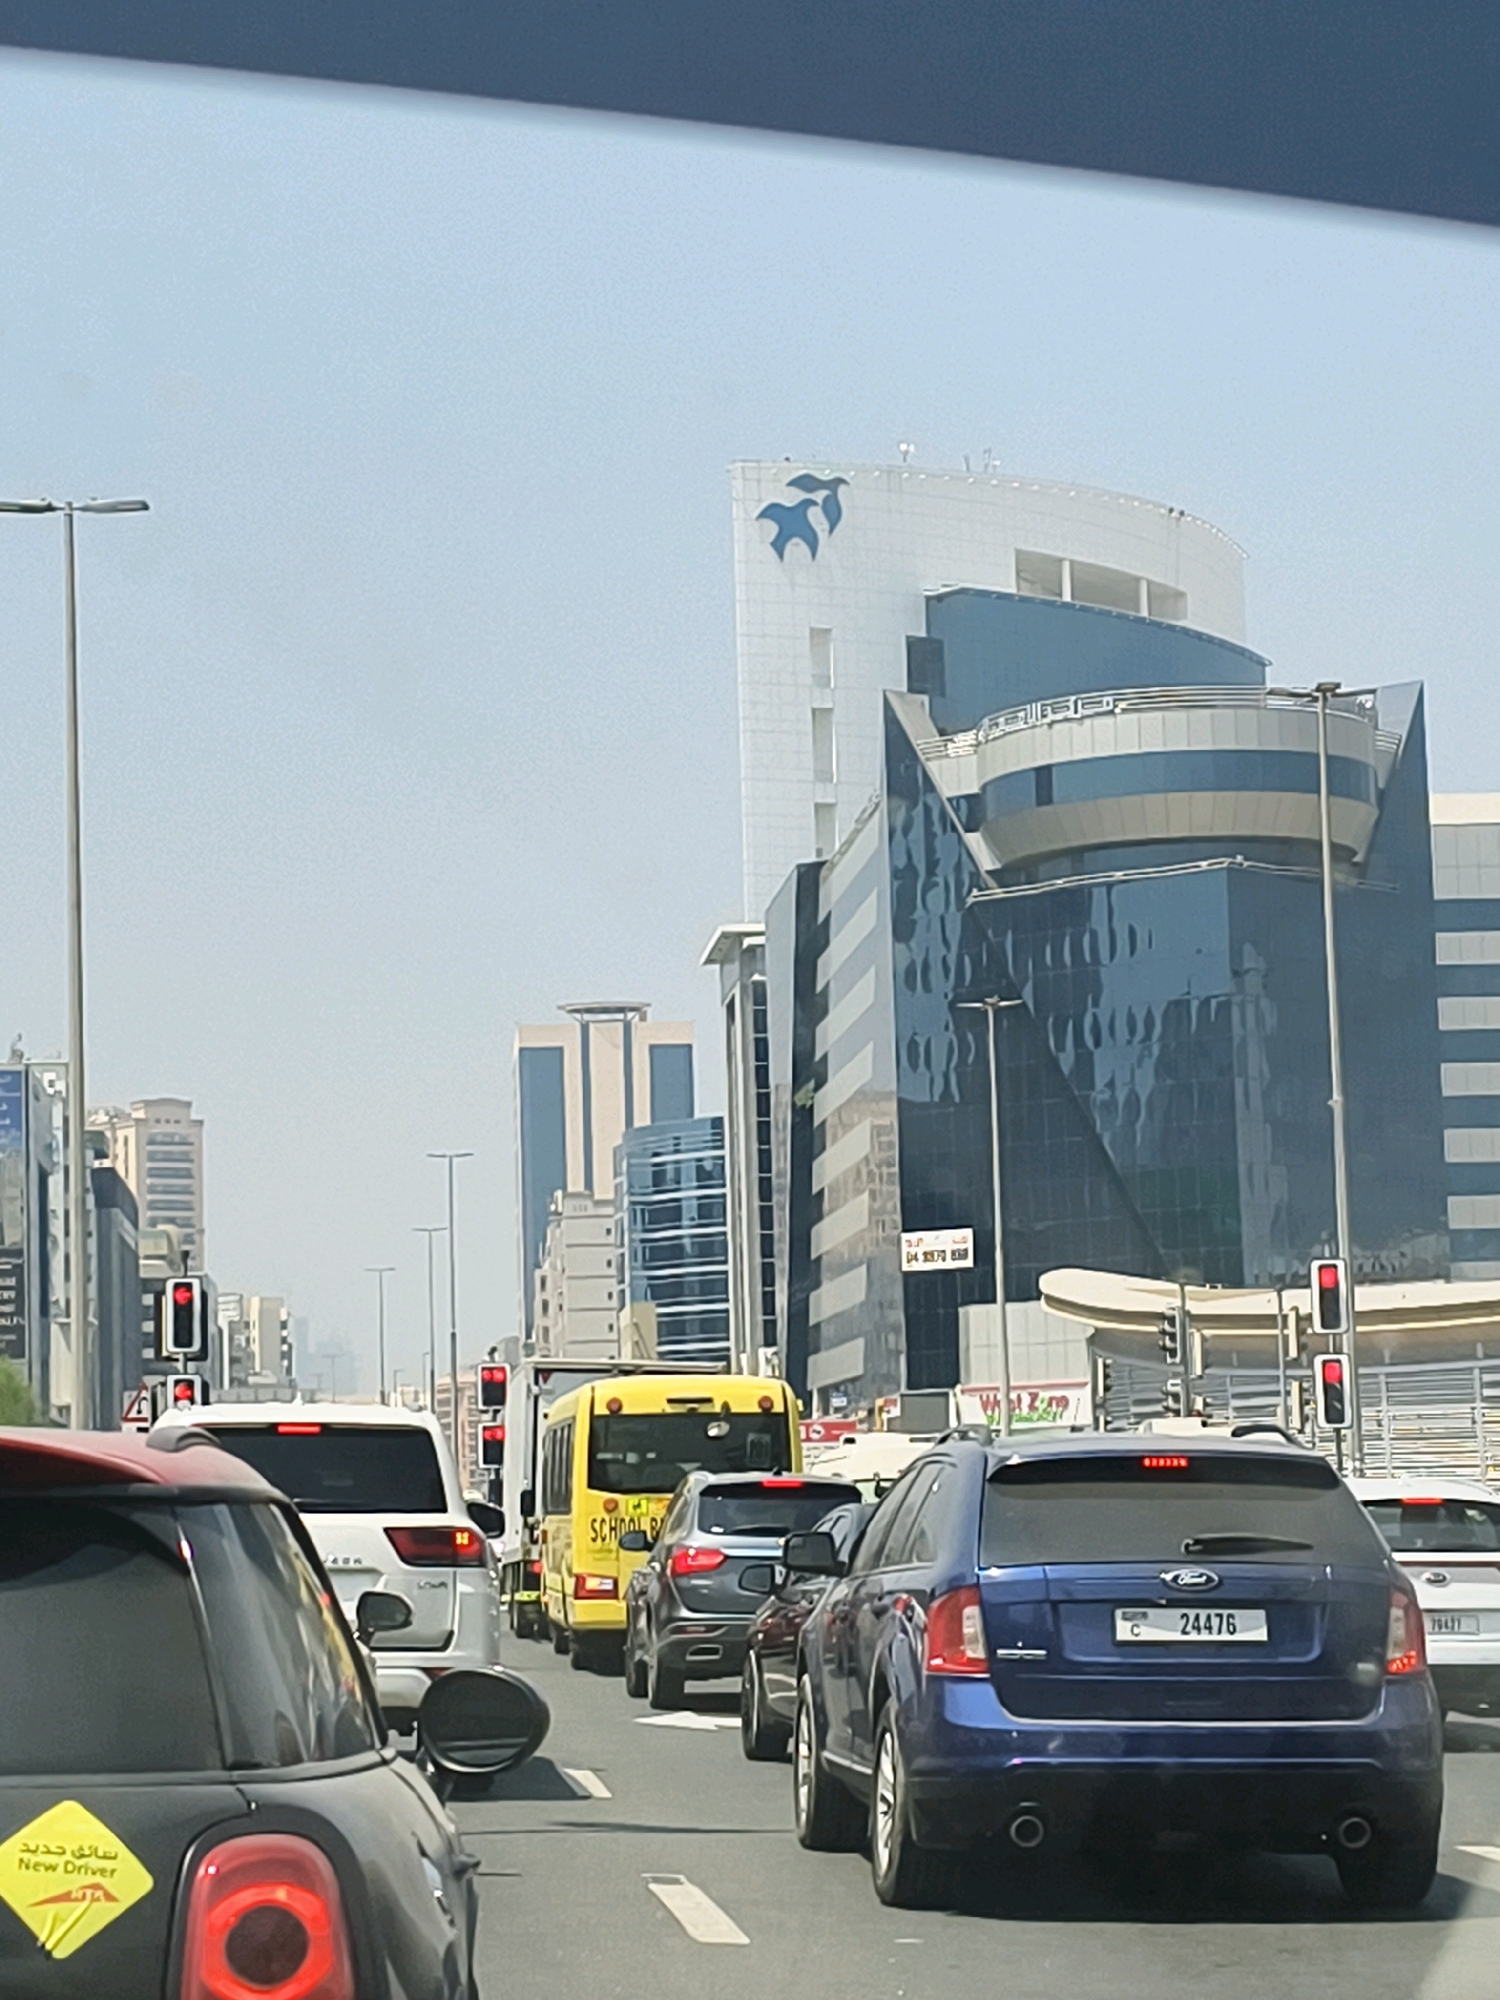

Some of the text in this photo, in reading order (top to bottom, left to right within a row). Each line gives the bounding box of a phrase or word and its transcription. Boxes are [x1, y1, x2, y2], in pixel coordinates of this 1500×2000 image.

[1130, 1612, 1237, 1637] C 24476
[18, 1858, 118, 1879] New Driver
